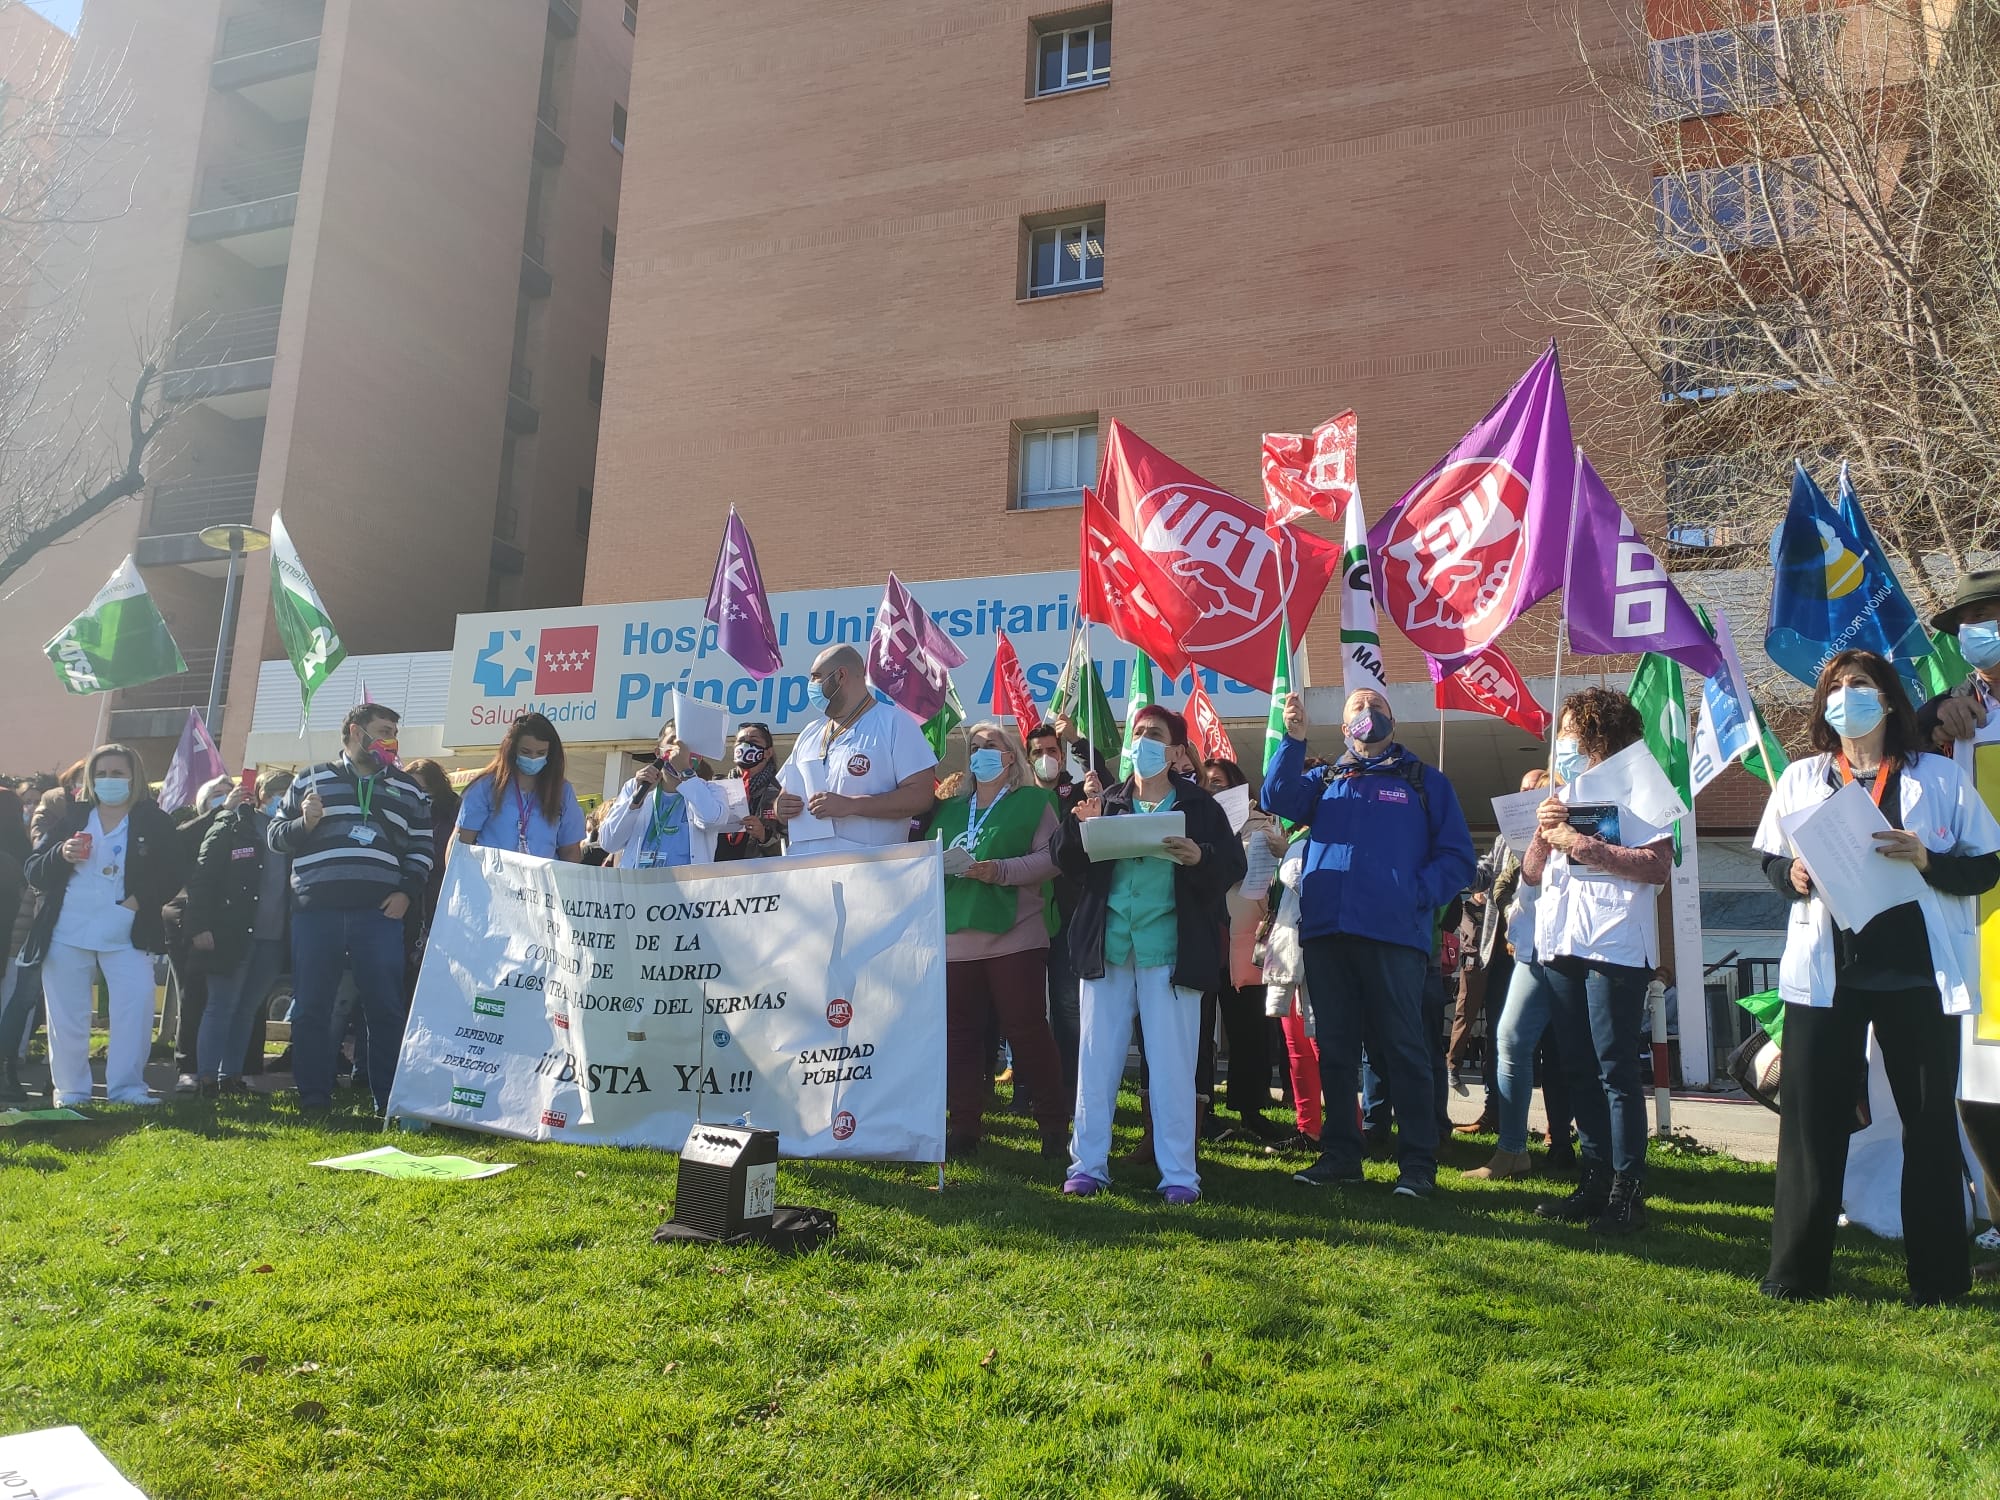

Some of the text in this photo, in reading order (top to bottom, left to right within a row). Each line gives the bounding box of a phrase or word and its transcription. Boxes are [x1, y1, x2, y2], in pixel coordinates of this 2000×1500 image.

[622, 611, 789, 660] Hospl
[615, 672, 812, 724] Príncip
[850, 757, 869, 770] UGT
[1379, 790, 1407, 799] CCOO
[562, 899, 636, 920] MALTRATO
[646, 895, 780, 922] CONSTANTE
[571, 929, 616, 950] PARTE
[635, 934, 660, 950] DE
[674, 934, 701, 952] LA
[592, 963, 613, 980] DE
[640, 963, 722, 981] MADRID
[513, 974, 545, 992] L@S
[652, 998, 693, 1015] DEL
[704, 991, 787, 1015] SERMAS
[476, 1000, 505, 1014] SATSE
[455, 1026, 505, 1046] DEFIENDE
[467, 1044, 486, 1055] TUS
[798, 1043, 875, 1064] SANIDAD
[442, 1054, 501, 1075] DERECHOS
[801, 1065, 873, 1086] PÚBLICA
[452, 1090, 484, 1103] SATSE
